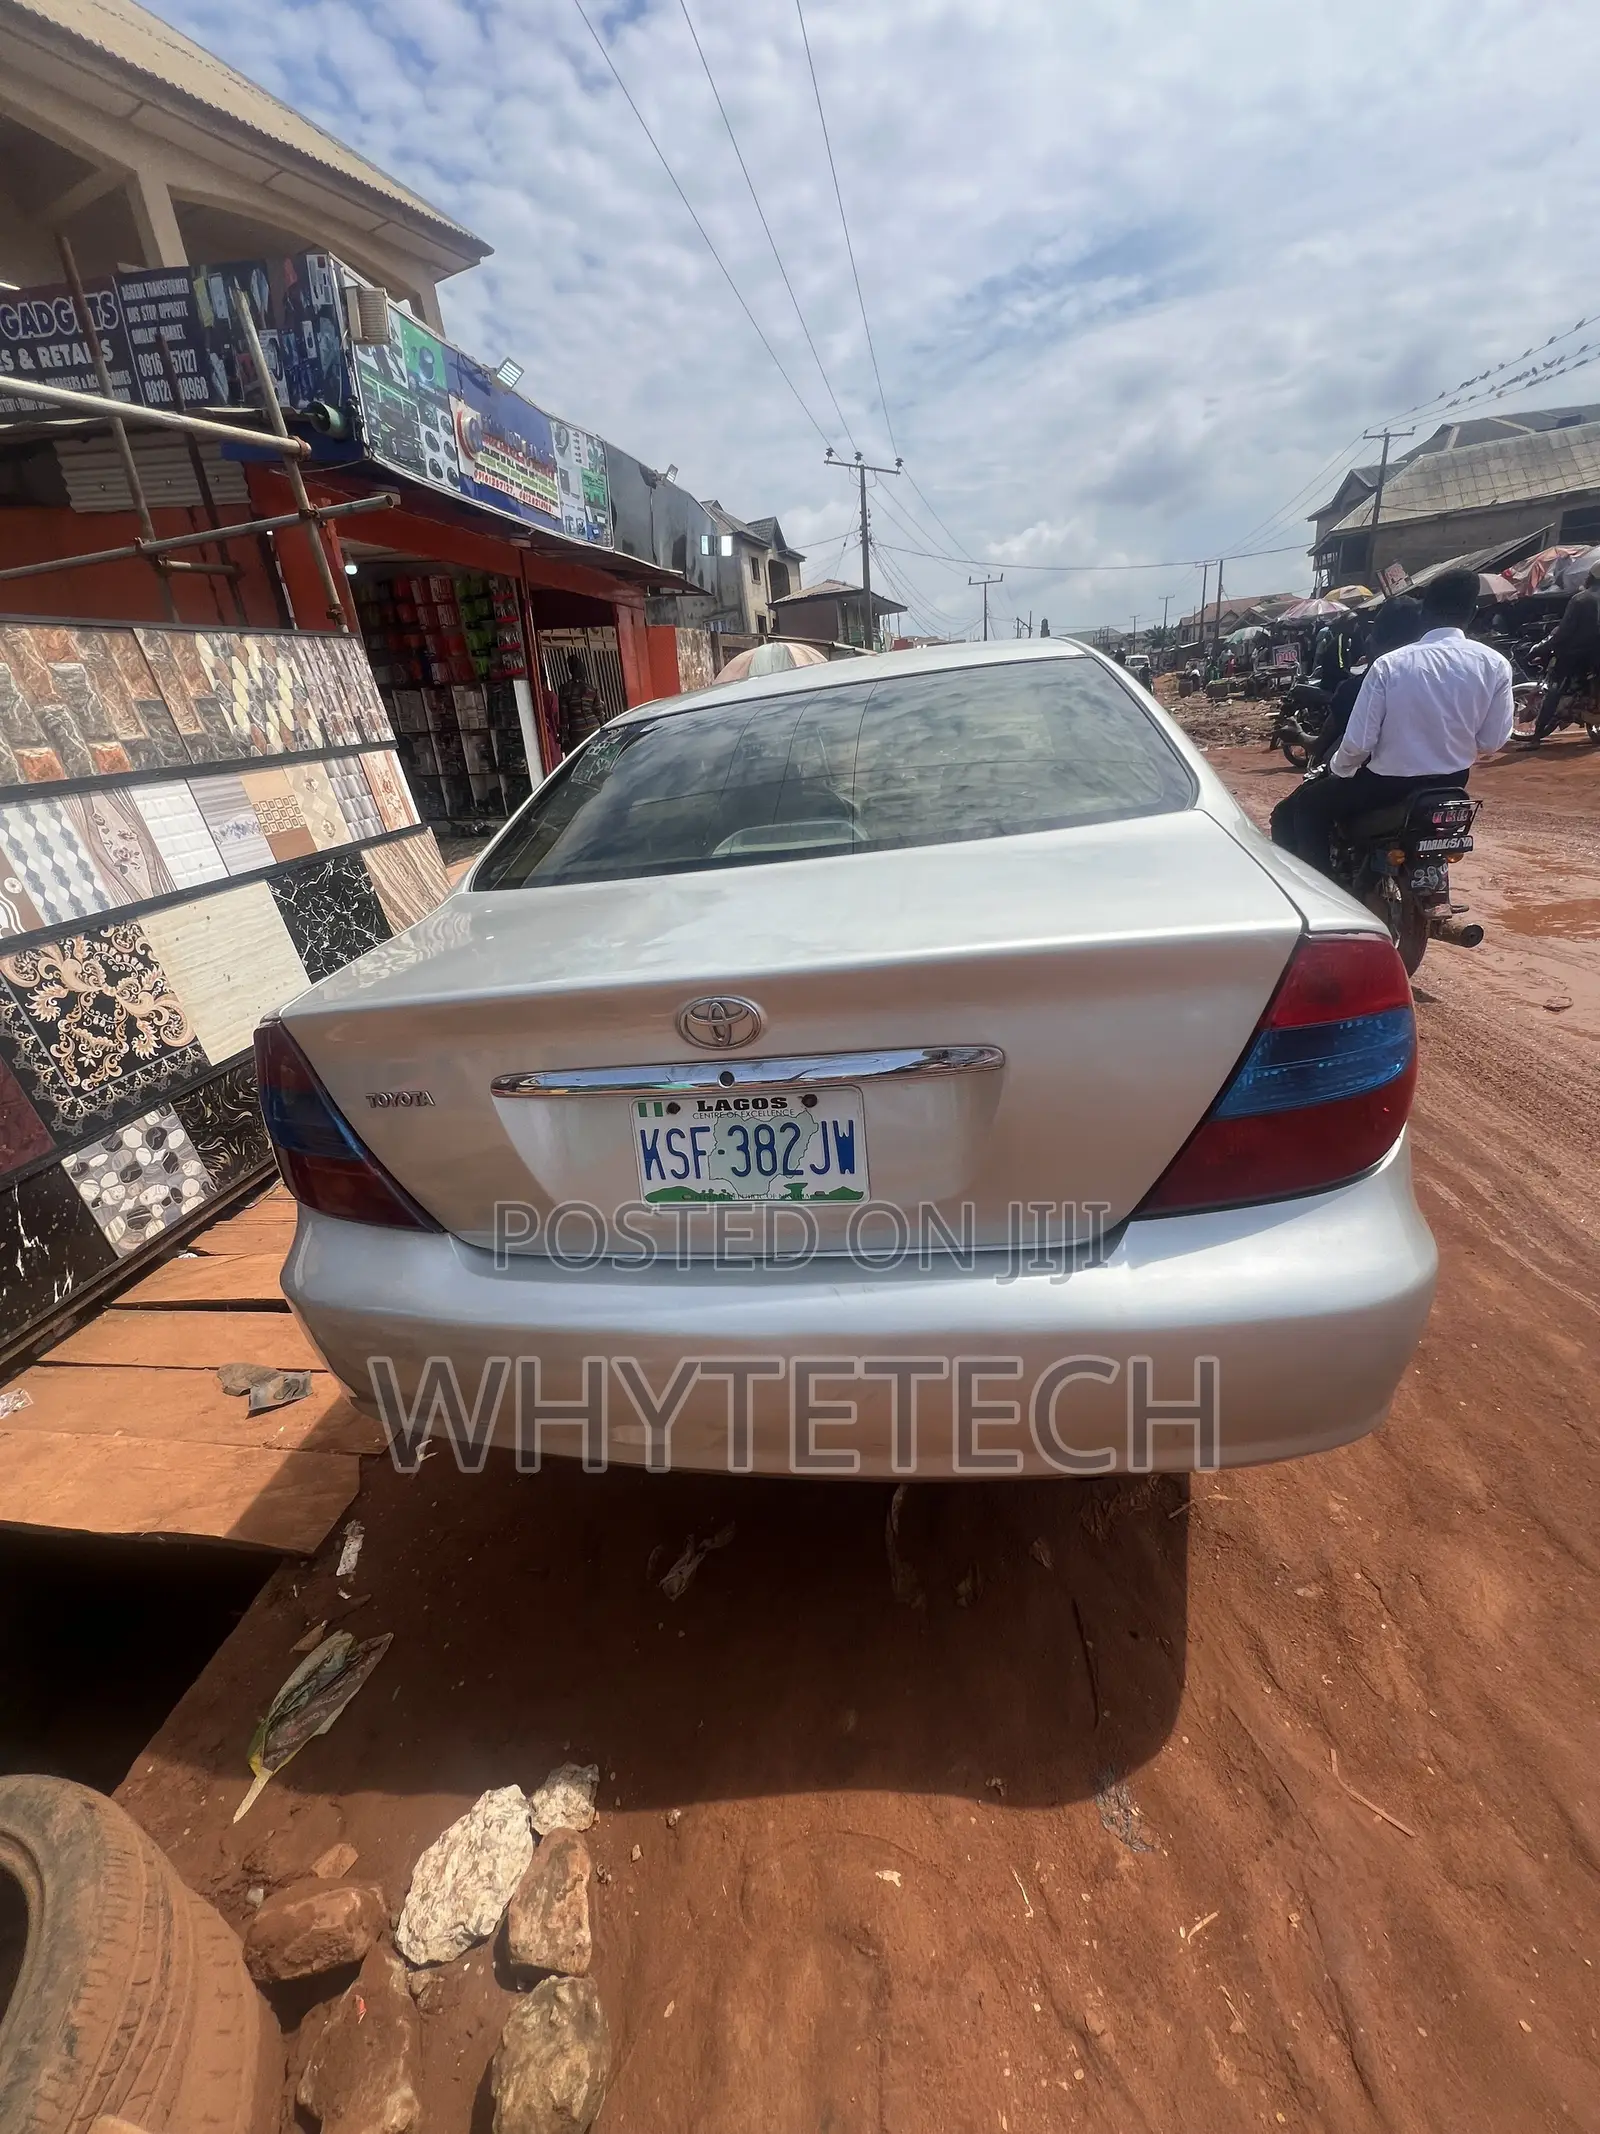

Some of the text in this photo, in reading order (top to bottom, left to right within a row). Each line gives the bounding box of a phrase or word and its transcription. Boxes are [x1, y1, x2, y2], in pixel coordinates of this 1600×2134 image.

[0, 291, 119, 341] GADGTS
[18, 347, 36, 370] &
[37, 339, 114, 368] RETAIS
[138, 349, 198, 377] 091657127
[365, 1089, 435, 1108] TOYOTA
[696, 1097, 788, 1112] LAGOS
[692, 1108, 795, 1120] CENTRE OF EXCELLENCE
